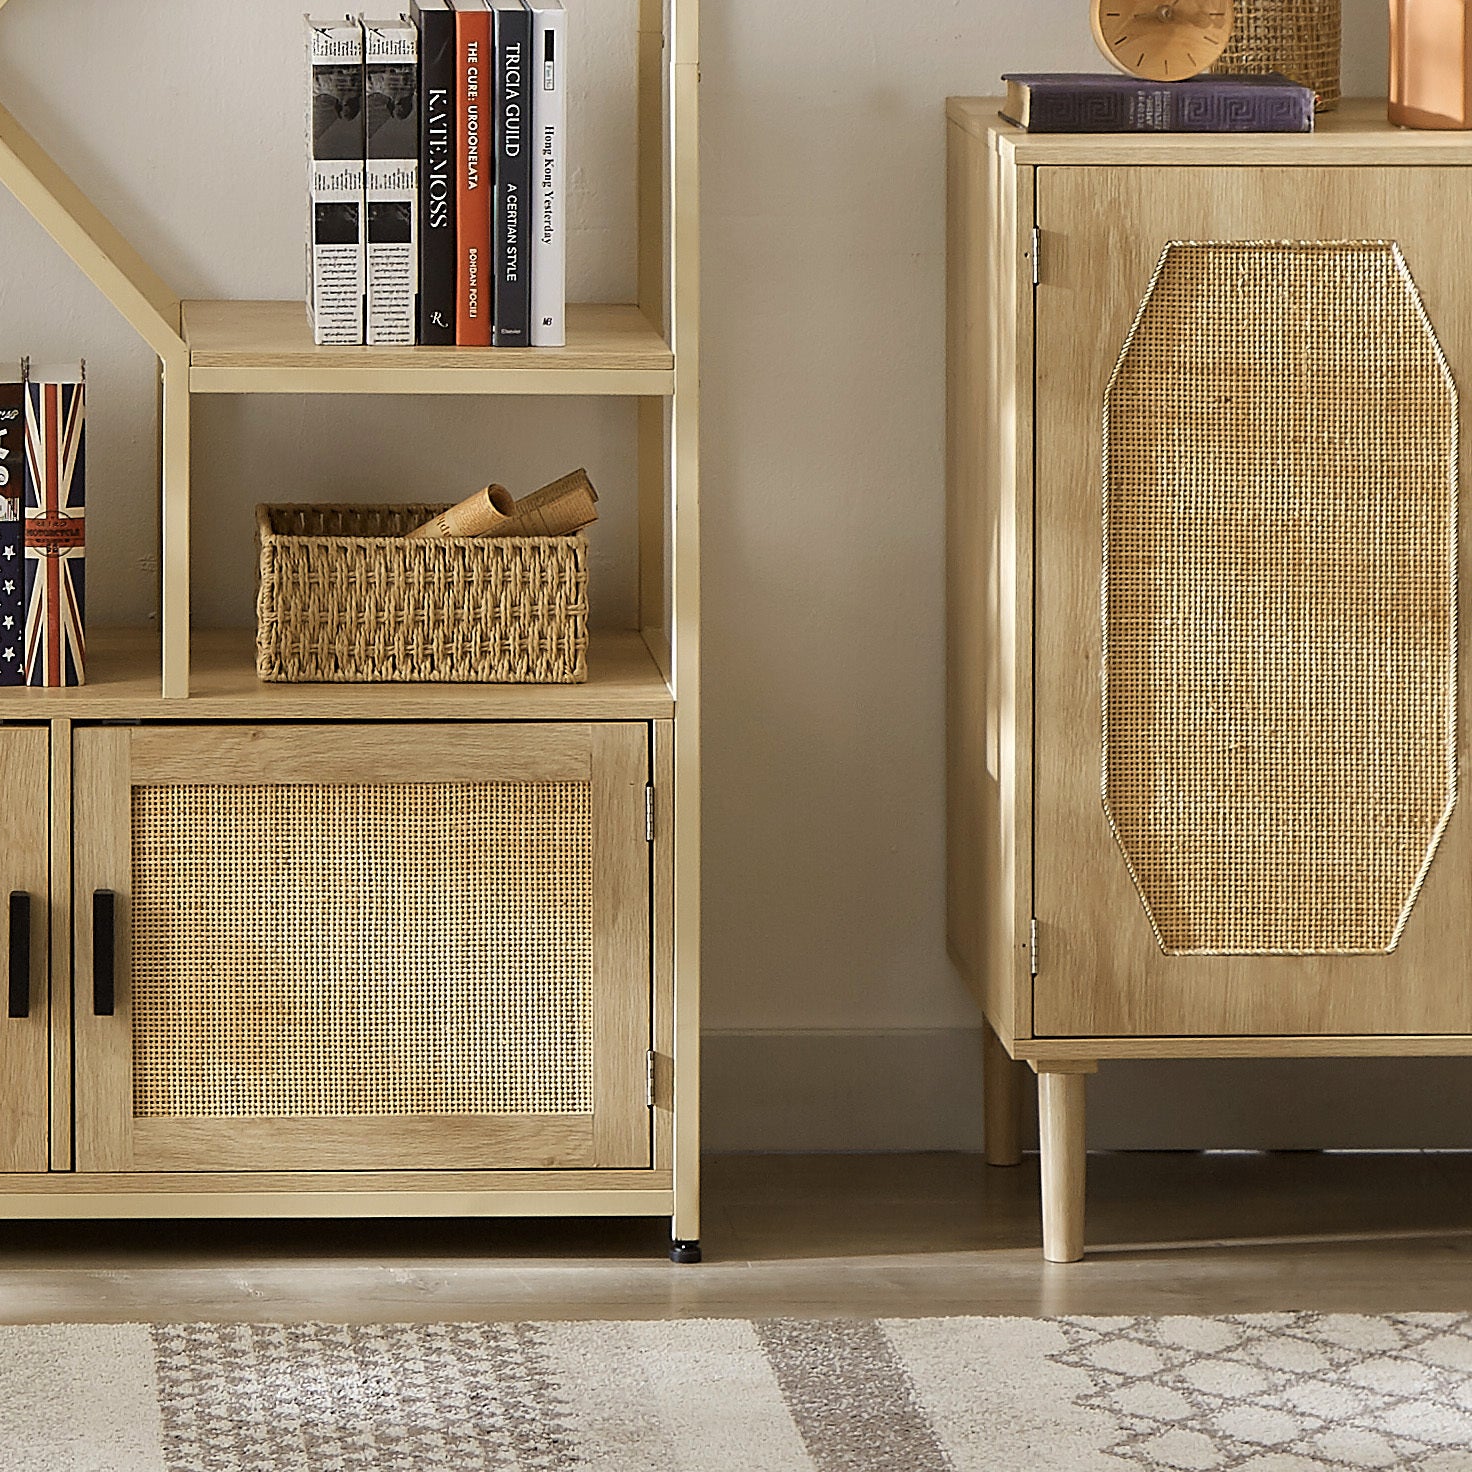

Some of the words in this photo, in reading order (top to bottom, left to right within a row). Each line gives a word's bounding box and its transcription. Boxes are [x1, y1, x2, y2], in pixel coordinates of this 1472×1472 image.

[467, 41, 478, 63] THE
[467, 66, 478, 101] CURE:
[505, 42, 520, 103] TRICIA
[467, 105, 479, 190] UROJONELATA
[506, 104, 520, 157] GUILD
[542, 126, 555, 155] Hong
[507, 183, 517, 193] A
[542, 158, 555, 188] Kong
[541, 191, 555, 245] Yesterday
[506, 247, 517, 282] STYLE
